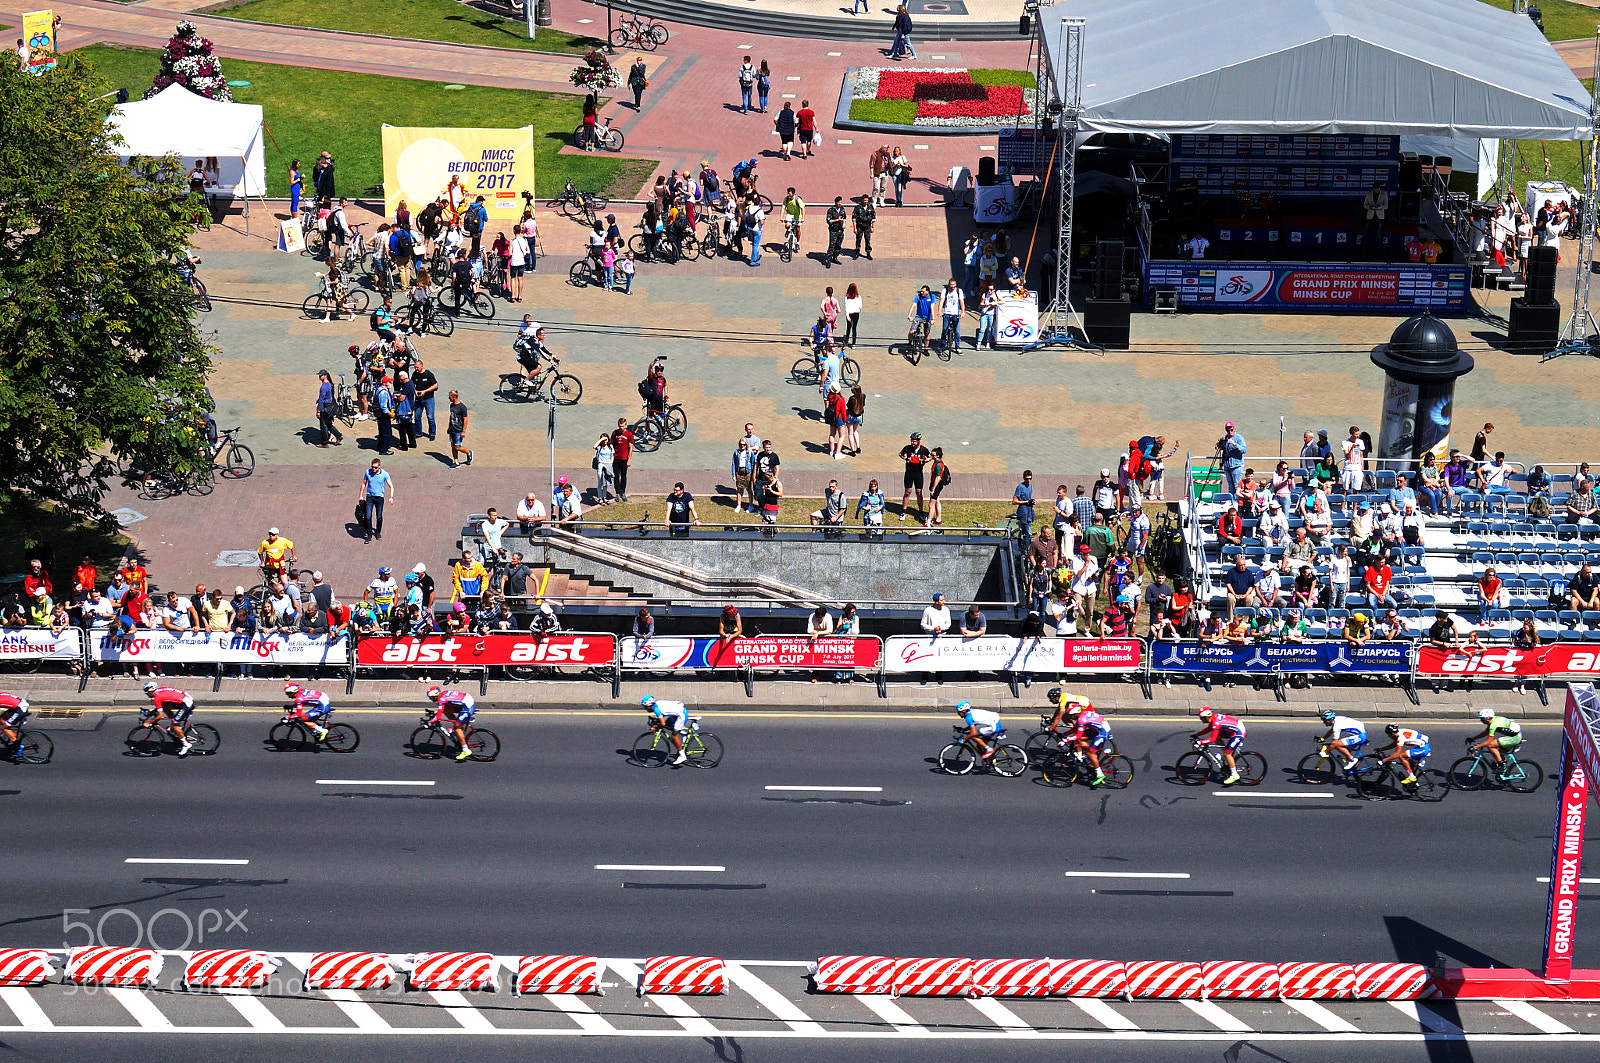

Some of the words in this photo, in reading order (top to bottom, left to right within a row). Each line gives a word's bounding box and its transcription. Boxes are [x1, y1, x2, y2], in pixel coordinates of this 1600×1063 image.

[481, 149, 515, 161] МИСС
[448, 161, 516, 173] ВЕЛОСПОРТ
[476, 174, 516, 189] 2017
[1244, 230, 1253, 241] 2
[1315, 232, 1323, 244] 1
[1382, 236, 1388, 244] 3
[1293, 279, 1330, 289] GRAND
[1333, 280, 1359, 289] PRIX
[1361, 280, 1396, 290] MINSK
[1293, 290, 1329, 299] MINSK
[1330, 290, 1353, 300] CUP
[0, 636, 28, 646] ANK
[158, 638, 208, 646] ВЕЛОСИПЕДНЫЙ
[382, 638, 462, 662] aist
[510, 638, 590, 662] aist
[734, 644, 780, 655] GRAND
[781, 644, 811, 654] PRIX
[814, 644, 855, 655] MINSK
[943, 645, 1007, 653] GALLERIA
[1015, 646, 1055, 654] MINSK
[1073, 643, 1132, 653] galleria-minsk.by
[1183, 647, 1234, 656] БЕЛАРУСЬ
[1267, 648, 1317, 656] БЕЛАРУСЬ
[1350, 648, 1401, 657] БЕЛАРУСЬ
[735, 654, 777, 665] MINSK
[778, 654, 805, 664] CUP
[1072, 653, 1132, 663] #galleriaminsk
[1441, 650, 1524, 672] aist
[1570, 706, 1592, 767] КУБОК
[1564, 802, 1583, 855] MINSK
[1560, 858, 1578, 895] PRIX
[1555, 899, 1573, 954] GRAND
